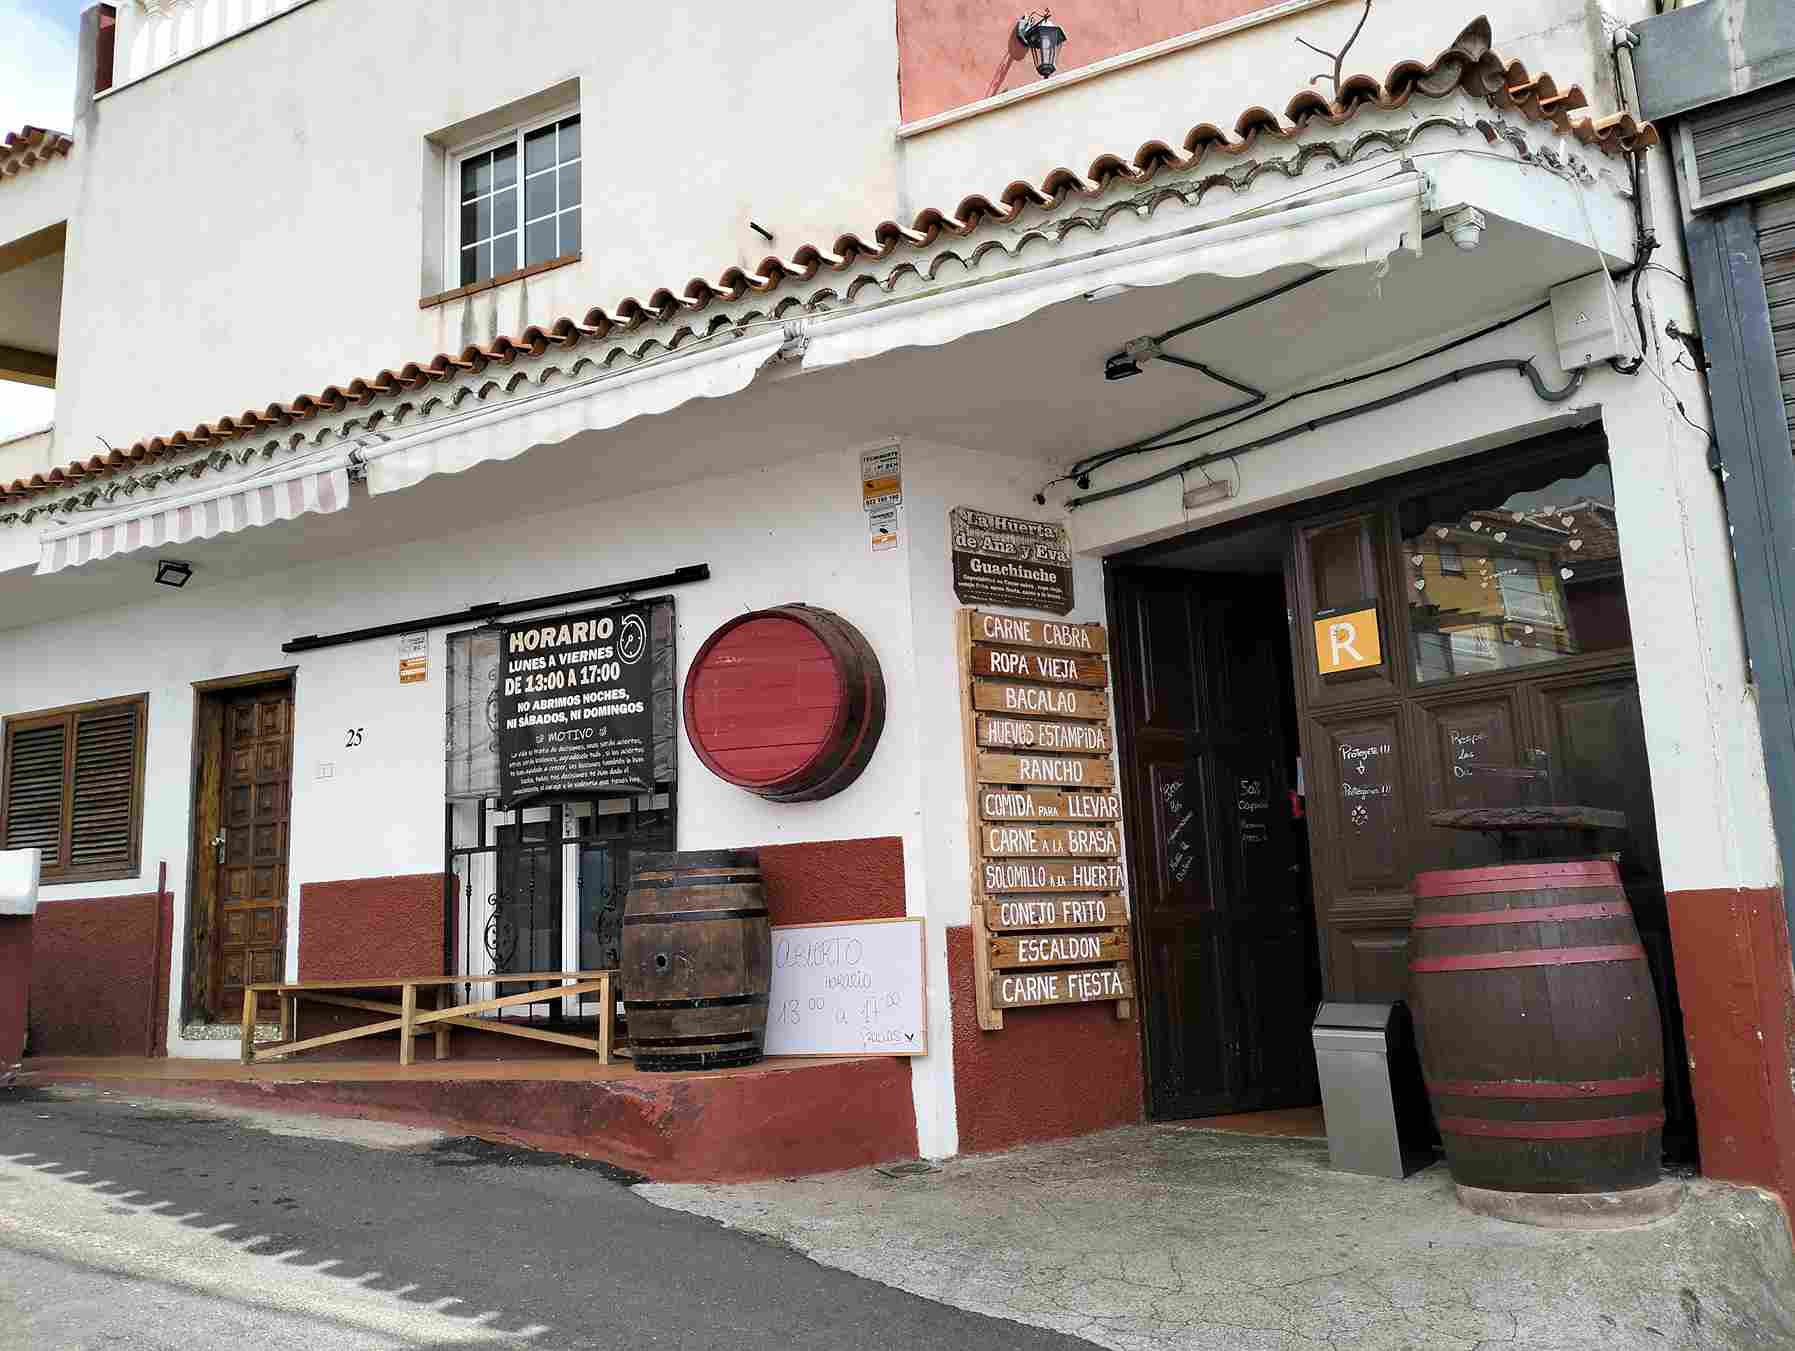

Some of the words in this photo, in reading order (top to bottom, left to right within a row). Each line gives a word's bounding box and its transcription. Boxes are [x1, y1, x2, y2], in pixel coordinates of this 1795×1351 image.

[966, 511, 989, 529] La
[994, 516, 1056, 538] Huerta
[955, 532, 977, 548] de
[982, 536, 1016, 554] Ana
[1021, 545, 1032, 560] y
[1035, 544, 1067, 562] Eva
[970, 558, 1057, 583] Guachinche
[509, 617, 614, 653] HORARIO
[983, 615, 1032, 642] CARNE
[1043, 623, 1092, 649] CABRA
[1328, 623, 1365, 666] R
[508, 656, 547, 674] LUNES
[548, 654, 557, 667] A
[558, 646, 614, 665] VIERNES
[990, 651, 1030, 675] ROPA
[1036, 657, 1079, 680] VIEJA
[505, 678, 522, 696] DE
[525, 669, 565, 693] 13:00
[567, 669, 577, 687] A
[580, 662, 621, 685] 17:00
[517, 700, 530, 713] NO
[531, 694, 581, 711] ABRIMOS
[582, 688, 630, 704] NOCHES,
[1005, 687, 1076, 713] BACALAO
[506, 718, 517, 729] NI
[518, 711, 569, 728] SÁBADOS,
[570, 710, 581, 721] NI
[583, 702, 645, 718] DOMINGOS
[345, 727, 364, 748] 25
[548, 727, 594, 742] MOTIVO
[988, 719, 1034, 745] HUEVOS
[1019, 759, 1083, 782] RANCHO
[985, 793, 1035, 817] COMIDA
[1038, 806, 1058, 817] PARA
[1068, 795, 1120, 818] LLEVAR
[990, 828, 1037, 853] CARNE
[1041, 840, 1050, 851] A
[1053, 839, 1064, 853] LA
[1068, 830, 1117, 853] BRASA
[1073, 865, 1125, 887] HUERTA
[1001, 902, 1056, 926] CONEJO
[1018, 936, 1101, 962] ESCALDON
[1002, 975, 1059, 1003] CARNE
